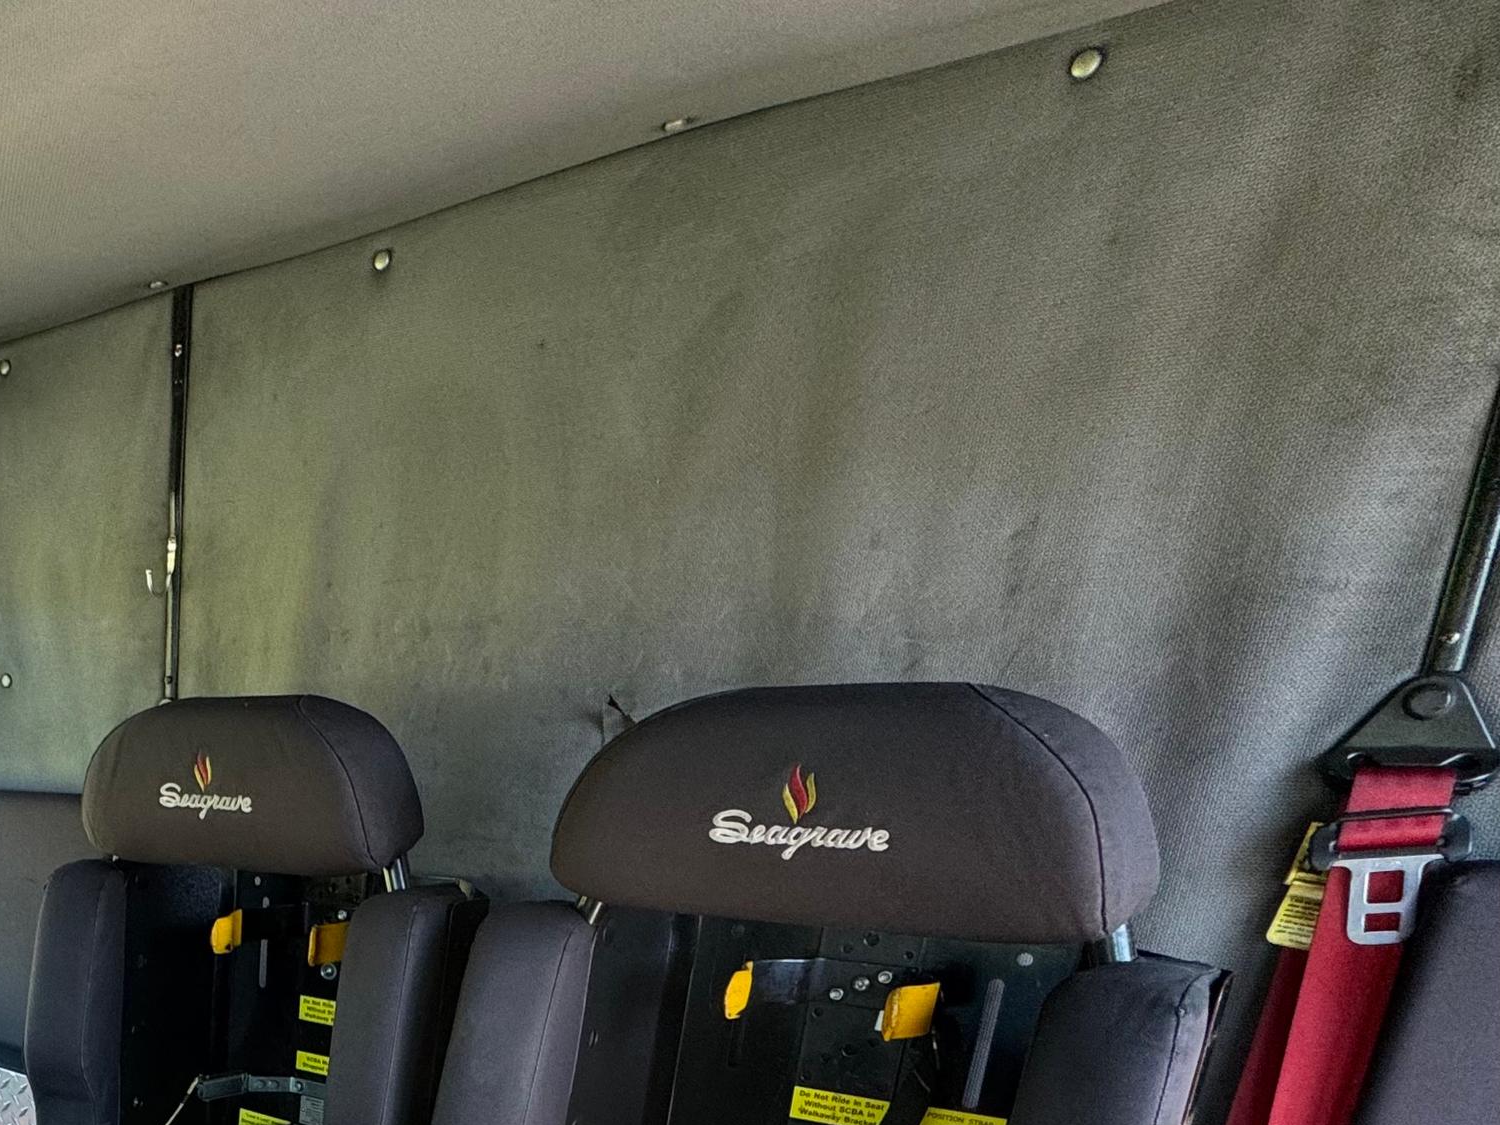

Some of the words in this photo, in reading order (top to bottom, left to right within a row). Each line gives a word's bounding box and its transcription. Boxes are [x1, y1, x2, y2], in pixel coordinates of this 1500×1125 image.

[159, 782, 252, 819] Seagrave
[708, 809, 890, 860] Seagrave
[799, 1090, 810, 1098] Do
[814, 1092, 828, 1101] Not
[832, 1095, 850, 1104] Ride
[864, 1101, 885, 1110] Seat
[804, 1100, 836, 1112] Without
[838, 1106, 864, 1116] SCBA
[798, 1107, 840, 1122] Walkaway
[926, 1111, 964, 1124] POSITION
